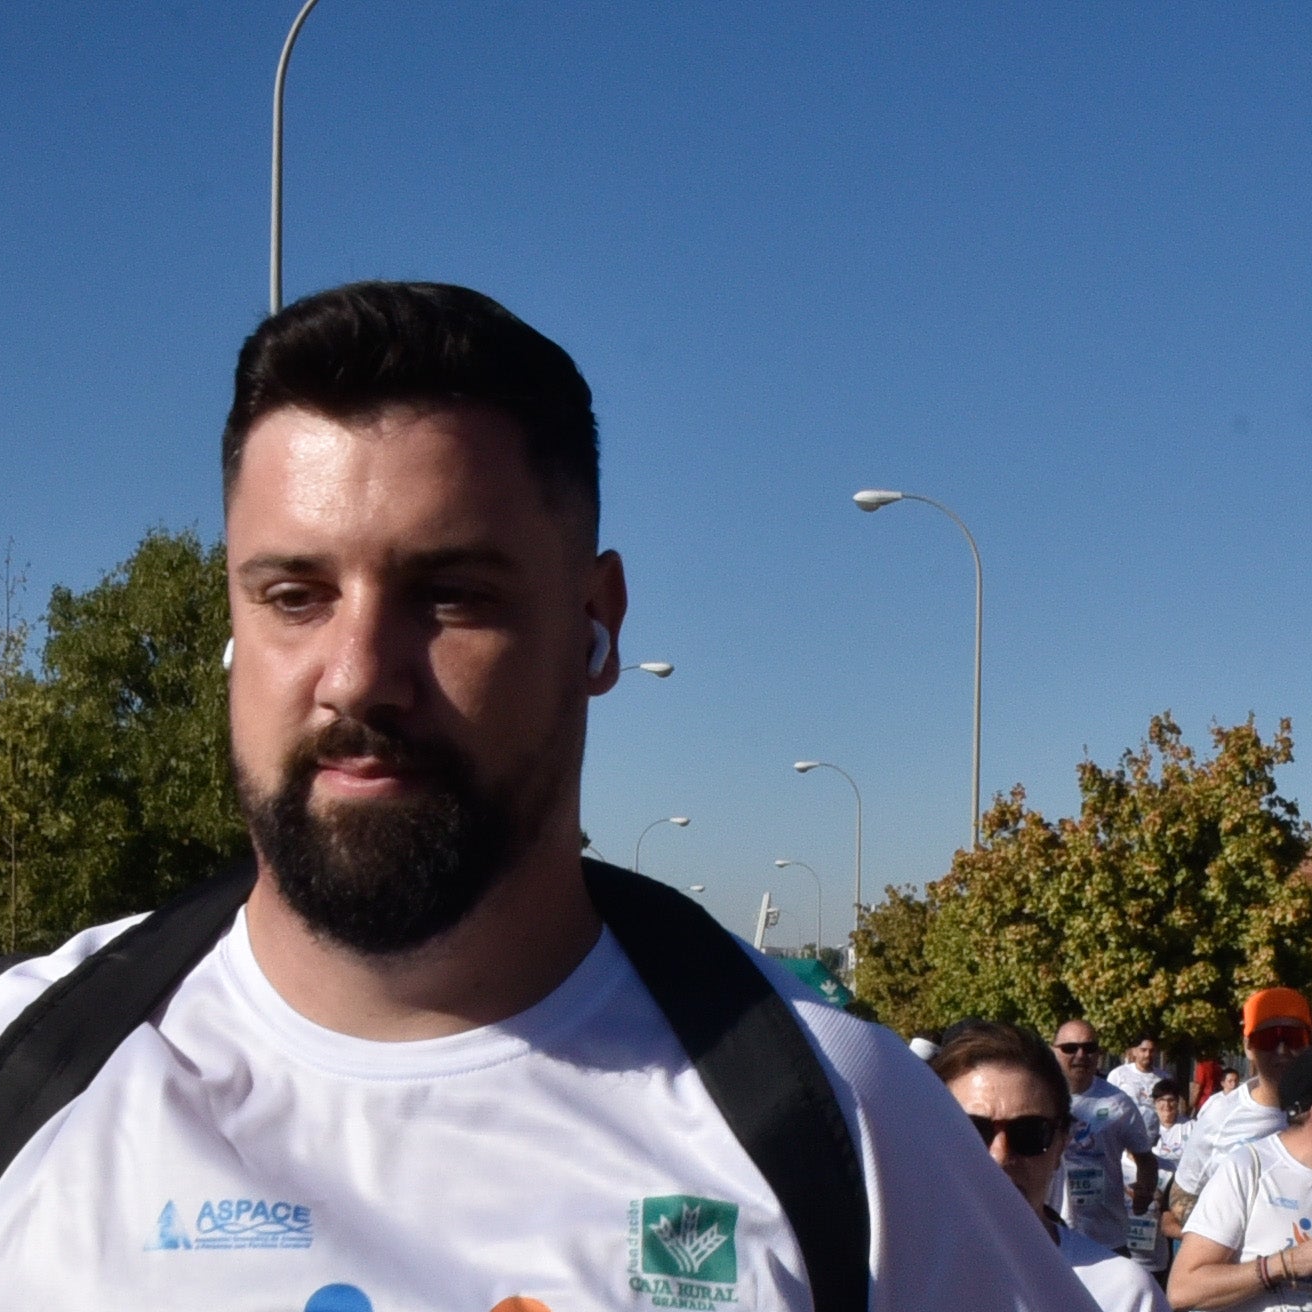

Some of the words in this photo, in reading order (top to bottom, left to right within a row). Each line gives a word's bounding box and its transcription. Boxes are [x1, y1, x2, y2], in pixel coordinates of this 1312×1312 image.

[197, 1199, 312, 1224] ASPACE
[629, 1276, 673, 1295] CAJA
[678, 1282, 739, 1303] RURAL
[651, 1296, 717, 1312] GRANADA
